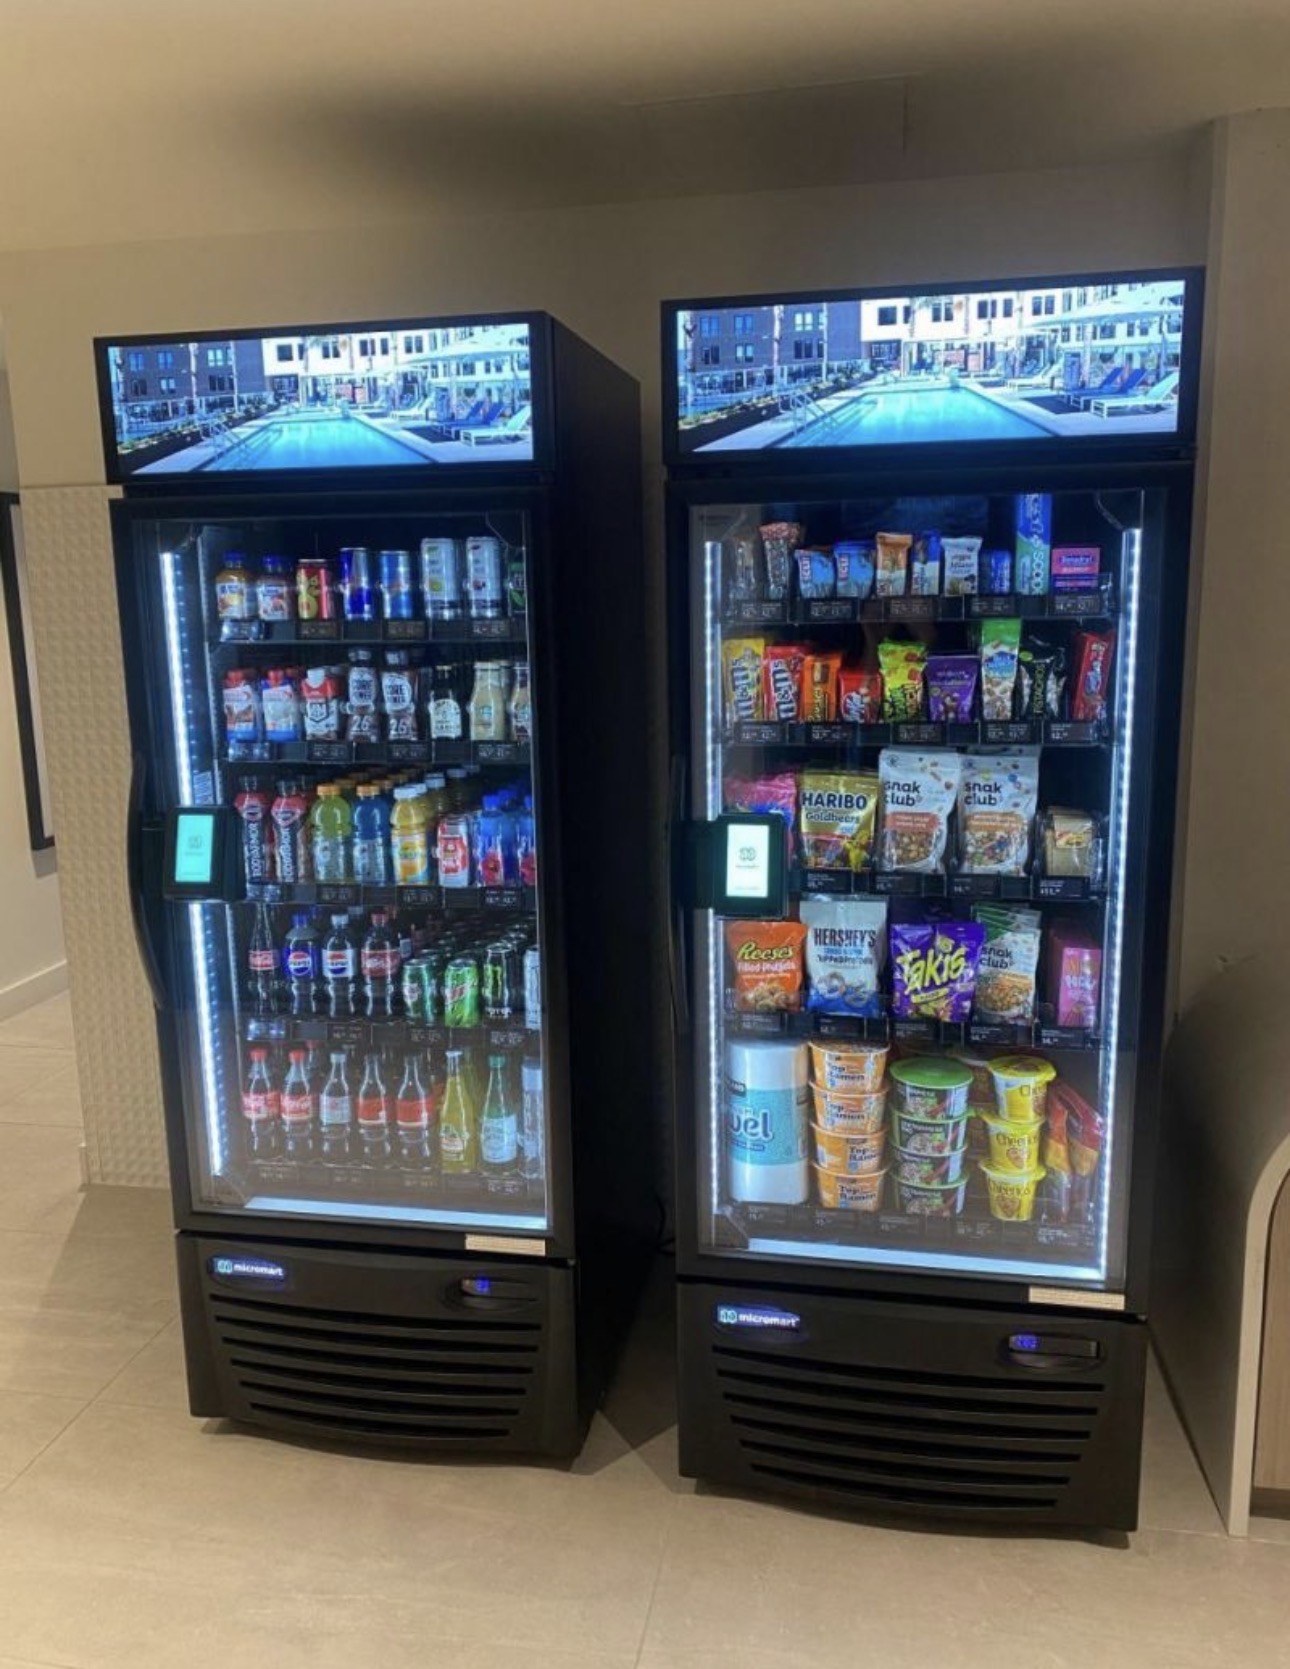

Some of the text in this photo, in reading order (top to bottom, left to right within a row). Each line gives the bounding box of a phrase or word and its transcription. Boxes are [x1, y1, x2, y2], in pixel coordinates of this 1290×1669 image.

[963, 781, 1003, 794] snak
[802, 792, 868, 810] HARIBO
[963, 793, 998, 807] club
[814, 928, 876, 947] HERSHEY'S
[233, 1262, 285, 1277] micromart
[738, 1312, 800, 1329] micromart
